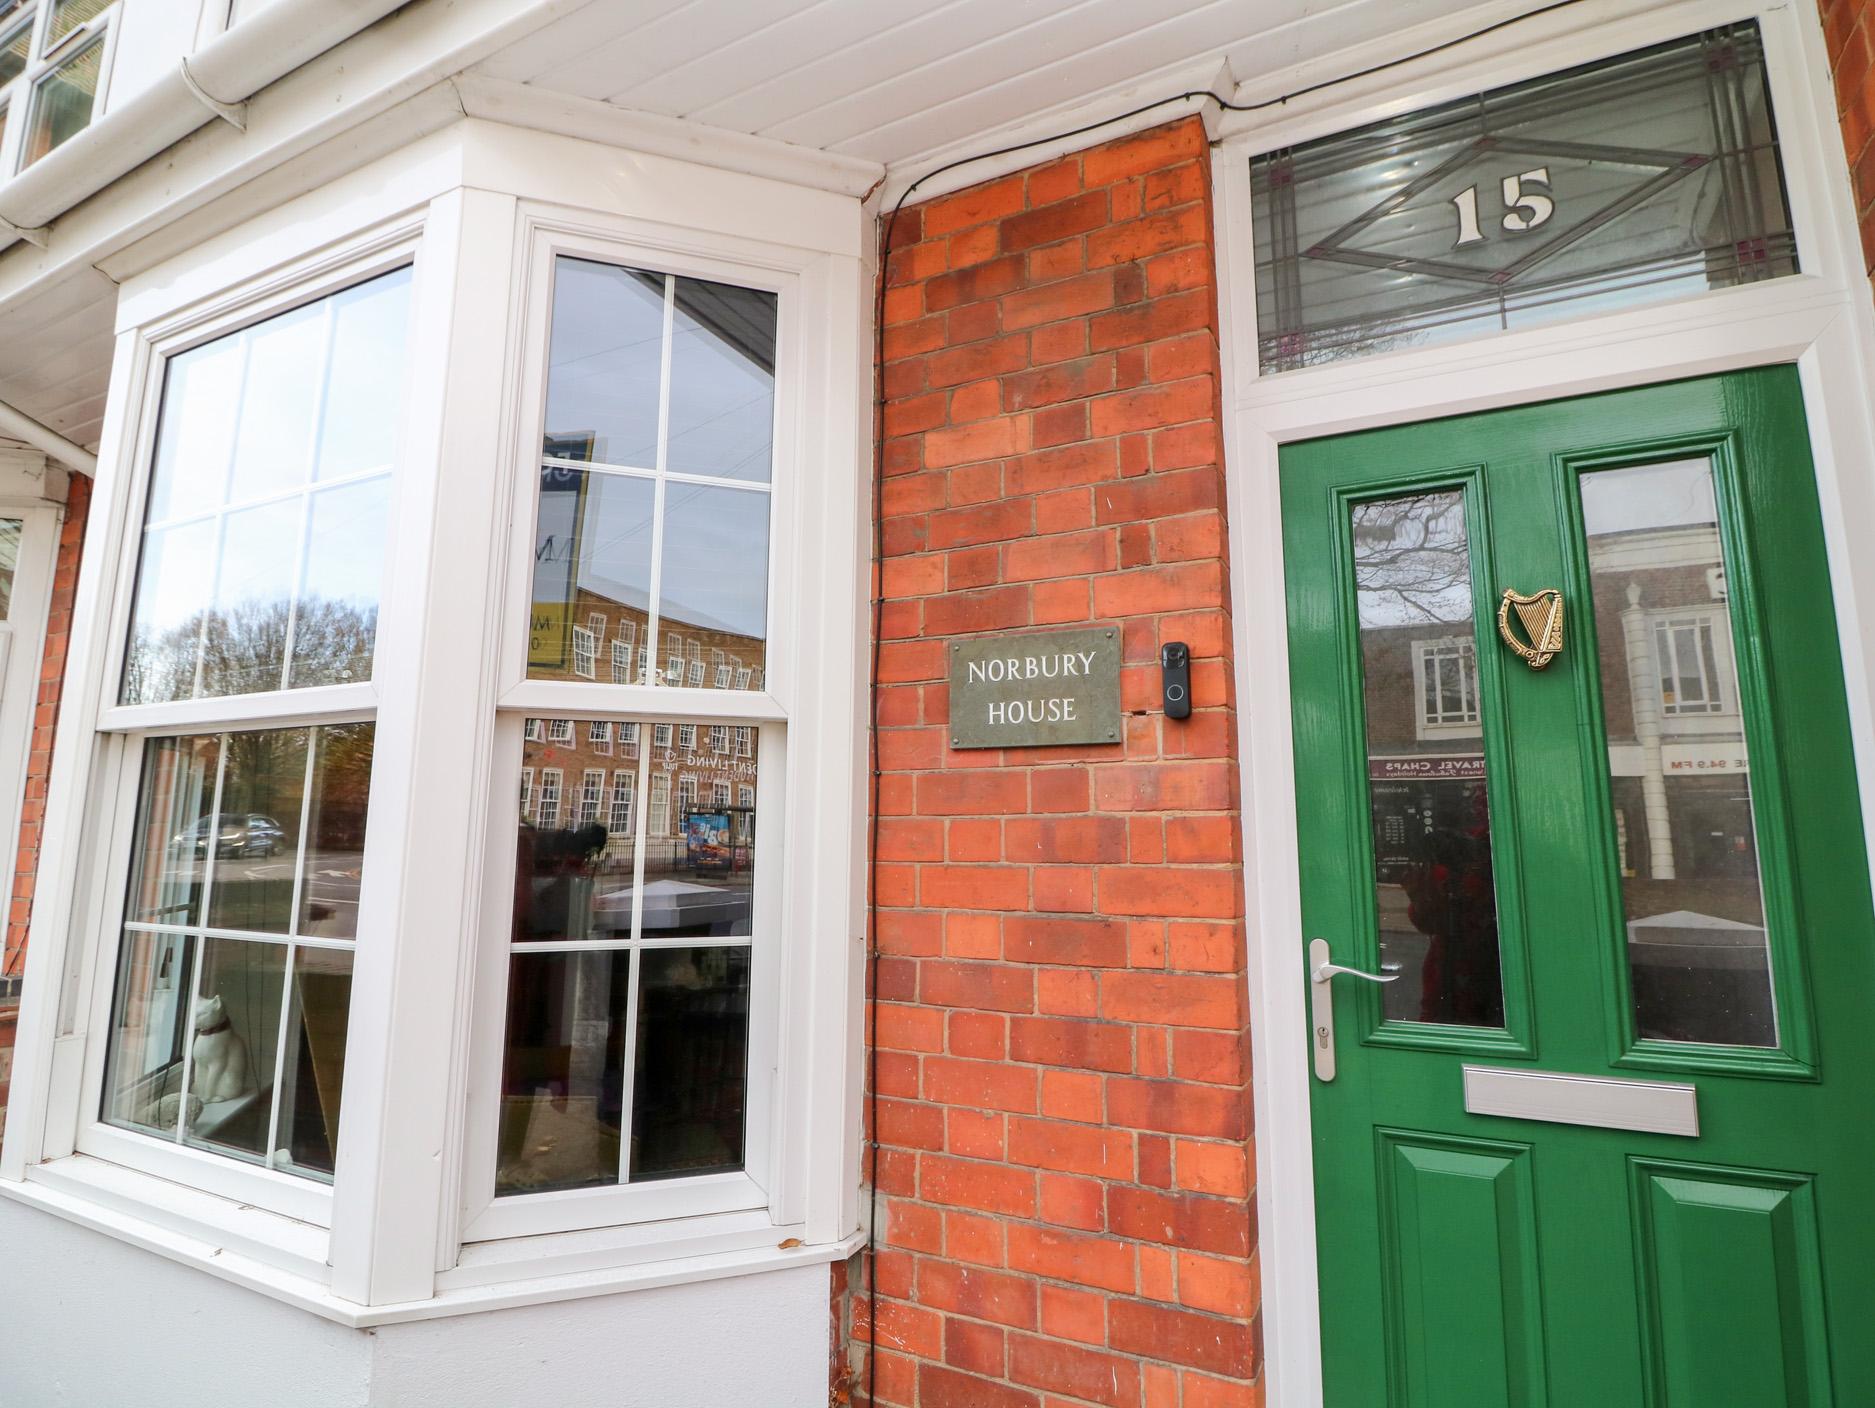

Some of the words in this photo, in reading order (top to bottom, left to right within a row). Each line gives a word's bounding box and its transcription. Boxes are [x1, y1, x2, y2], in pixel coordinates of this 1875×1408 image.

[1452, 166, 1555, 247] 15
[968, 651, 1097, 684] NORBURY
[988, 698, 1077, 725] HOUSE
